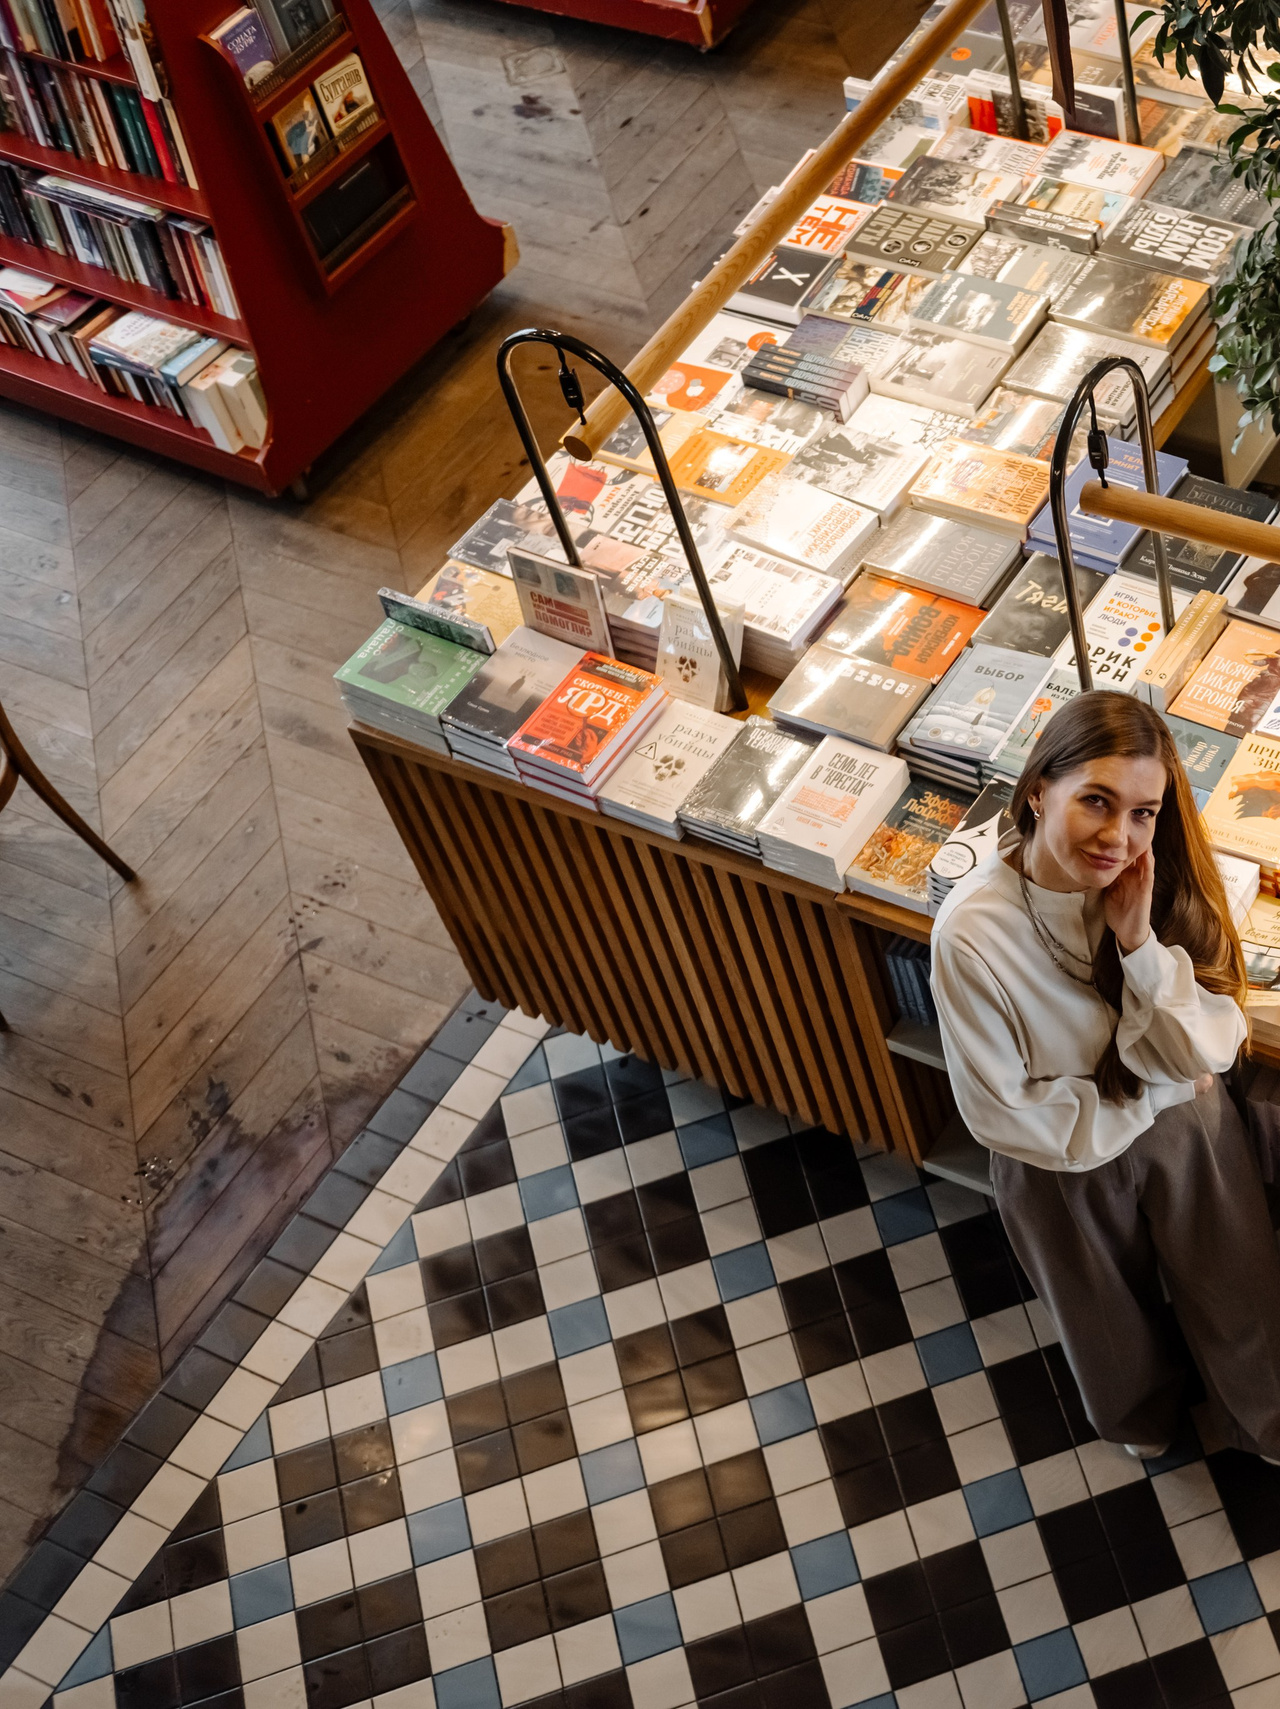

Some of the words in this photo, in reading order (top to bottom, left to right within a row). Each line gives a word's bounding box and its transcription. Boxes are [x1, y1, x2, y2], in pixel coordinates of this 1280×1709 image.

[786, 203, 833, 244] ТЕМ
[804, 205, 858, 251] НЕ
[1130, 211, 1177, 255] БУЛЫ
[1154, 218, 1206, 262] НАМ
[1182, 226, 1234, 270] СОМ
[1103, 384, 1121, 404] НАЦИЯ
[945, 541, 987, 587] ПОСЛЕ
[961, 542, 1007, 592] НЕМЦЫ
[1108, 598, 1115, 606] В
[1116, 600, 1158, 618] КОТОРЫЕ
[1114, 590, 1139, 604] ИГРЫ,
[1098, 613, 1126, 627] ЛЮДИ
[1103, 606, 1140, 622] ИГРАЮТ
[974, 665, 1024, 683] ВЫБОР
[1208, 656, 1260, 680] ТЫСЯЧЕ-
[573, 677, 632, 703] СКОТЛЕНД-
[1198, 671, 1242, 694] ЛИКАЯ
[558, 687, 624, 725] ЯРД
[1186, 685, 1246, 714] ГЕРОИНЯ
[672, 723, 718, 743] разум
[657, 734, 715, 759] убийцы
[810, 766, 821, 780] В
[828, 752, 858, 774] СЕМЬ
[855, 762, 879, 780] ЛЕТ
[1245, 927, 1269, 939] всем
